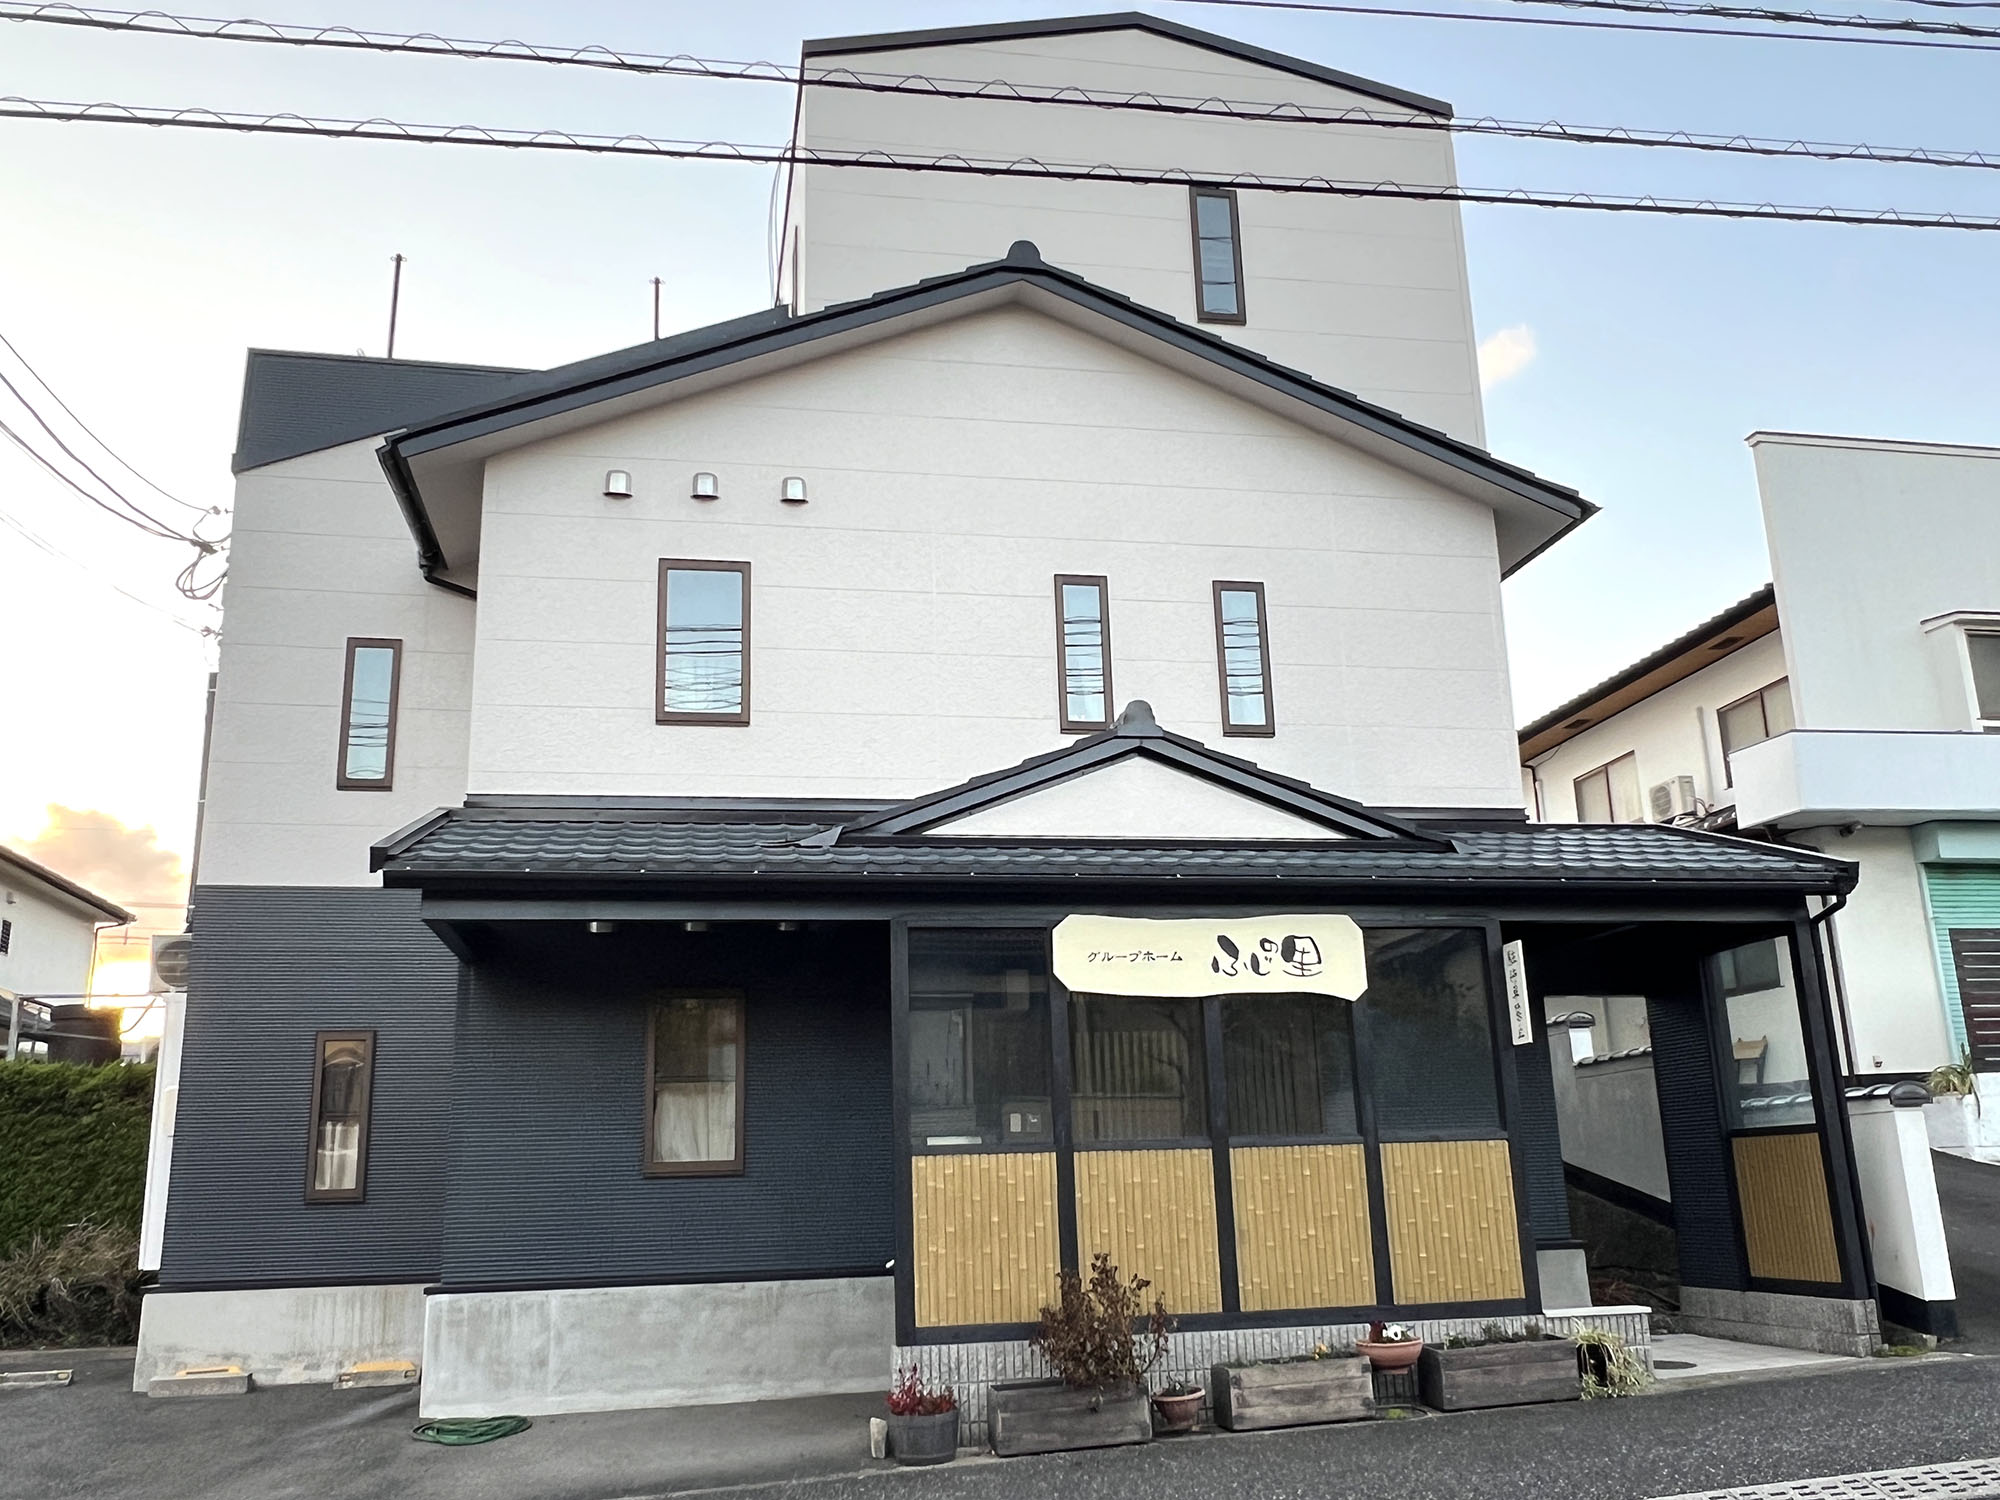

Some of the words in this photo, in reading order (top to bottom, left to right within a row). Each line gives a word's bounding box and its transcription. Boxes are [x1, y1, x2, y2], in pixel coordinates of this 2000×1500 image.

[1087, 950, 1184, 963] グループホーム
[1211, 934, 1323, 978] ふじの里
